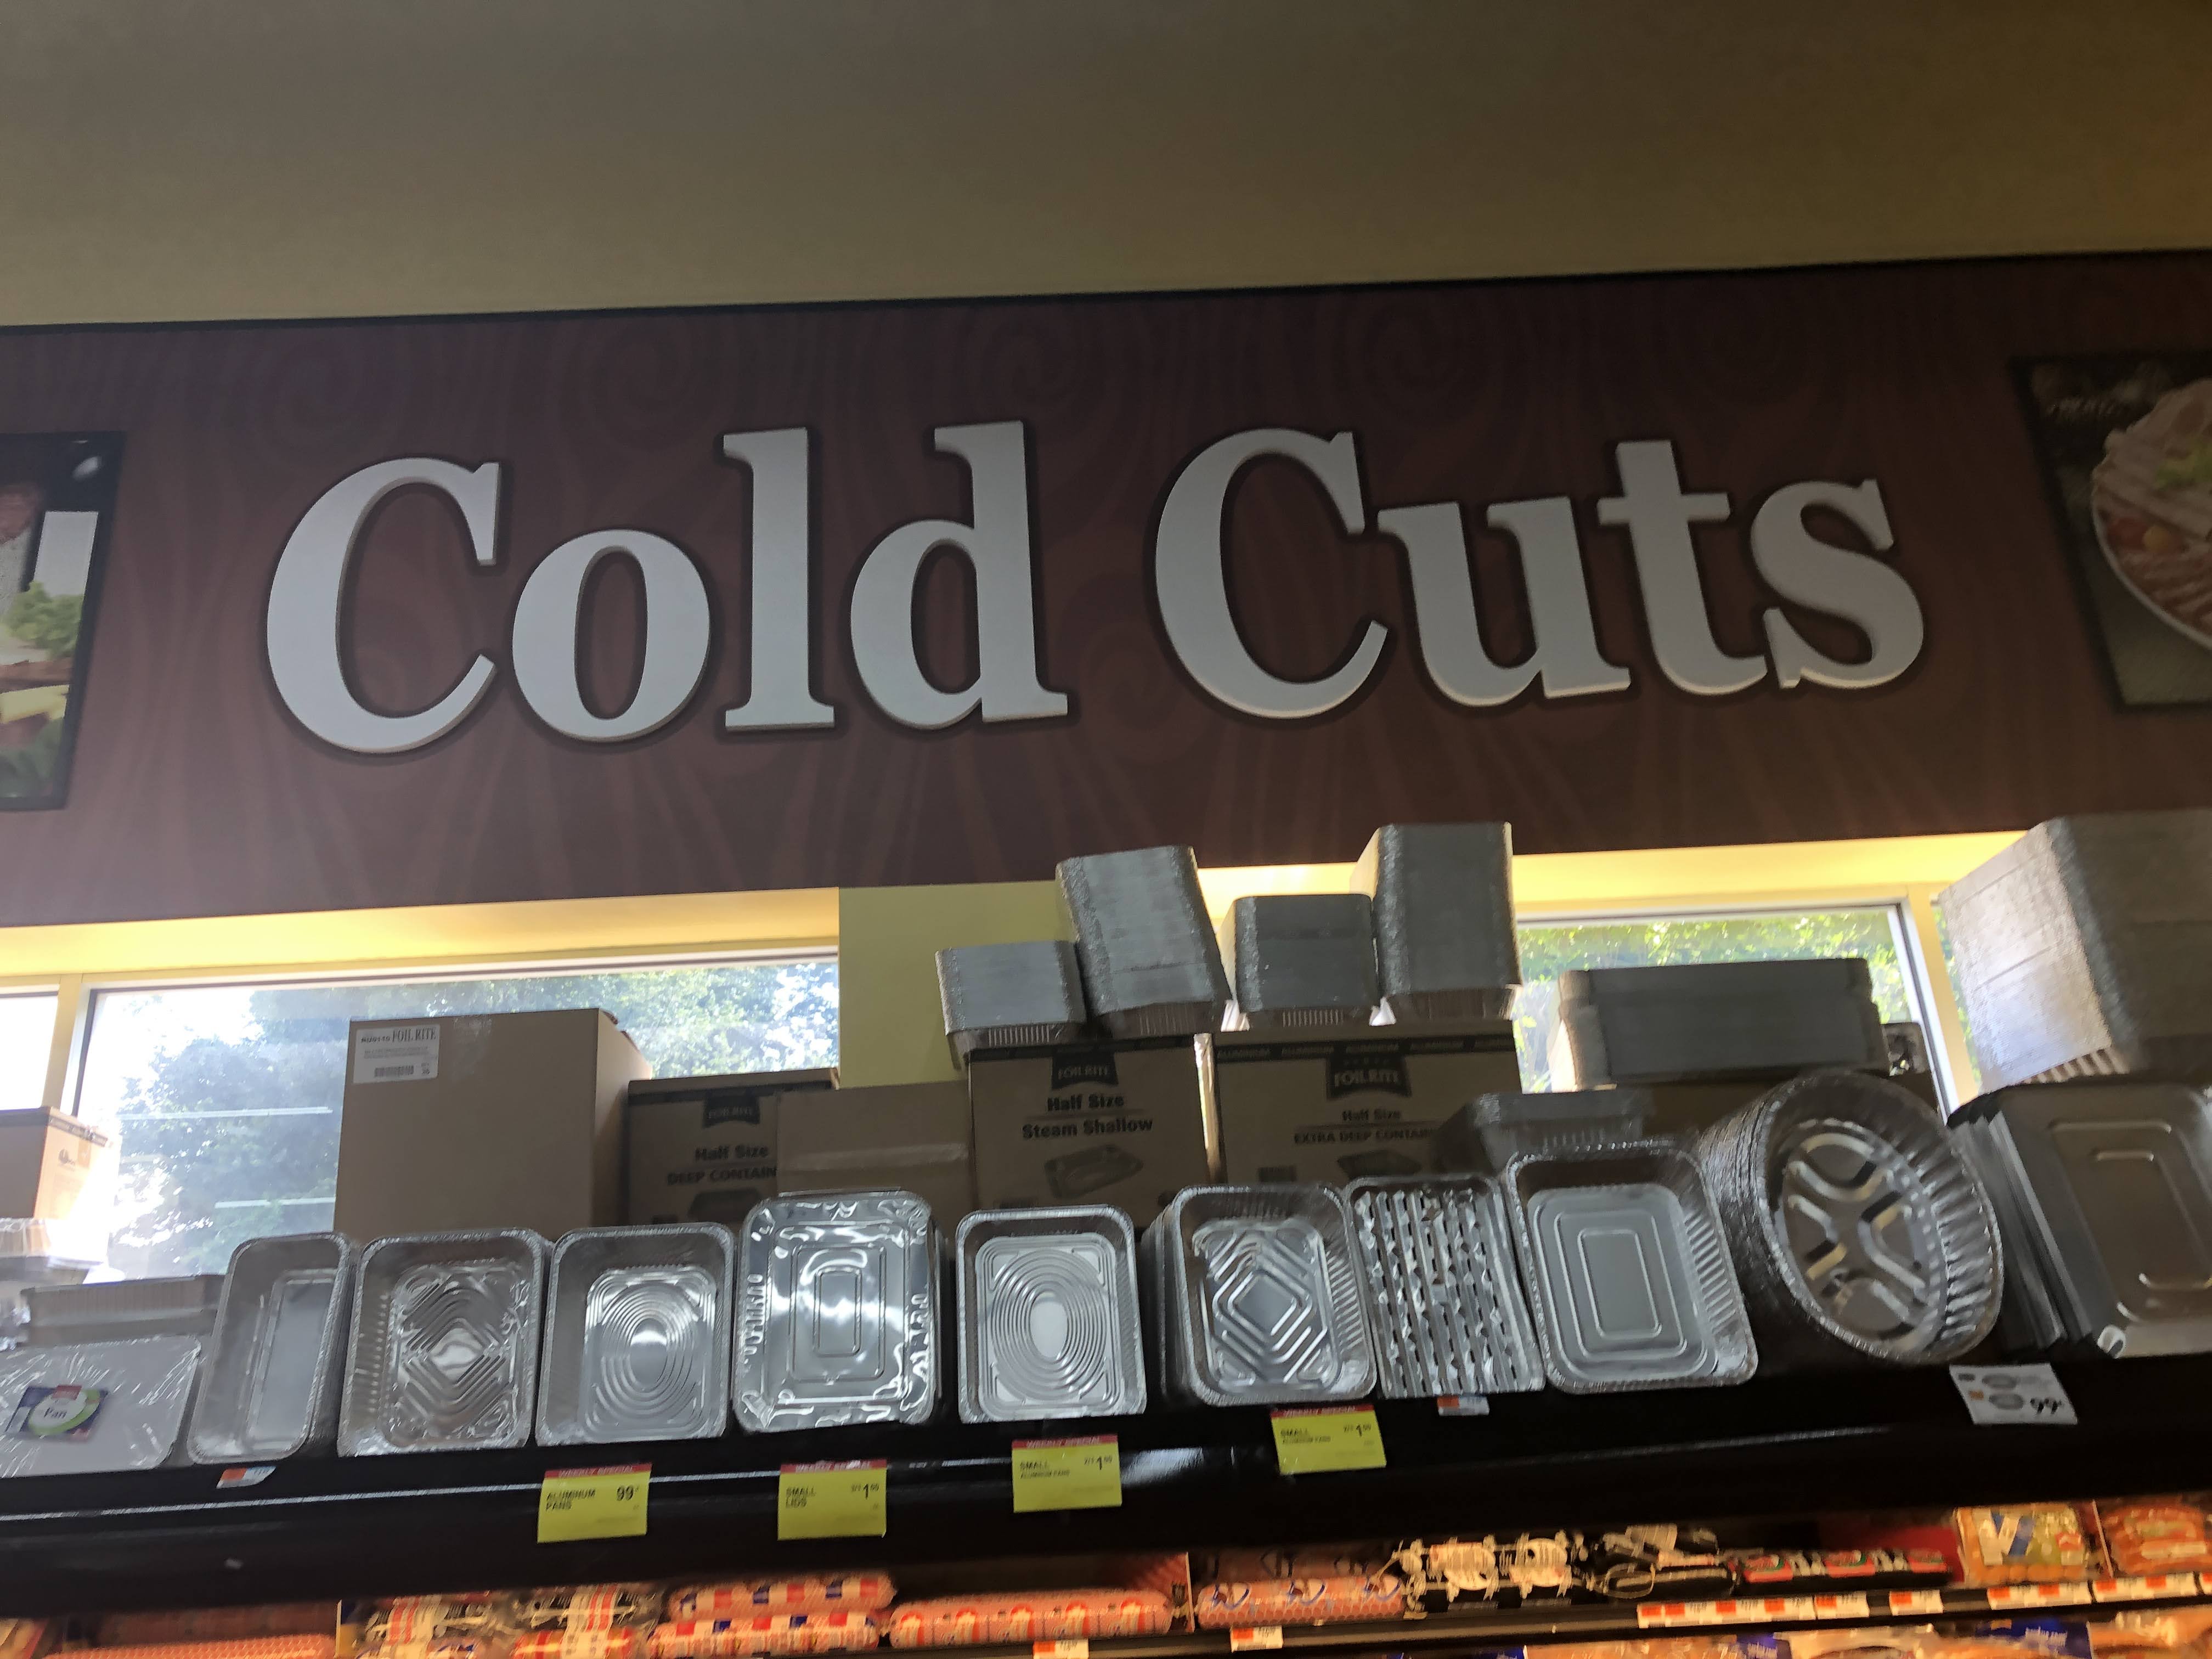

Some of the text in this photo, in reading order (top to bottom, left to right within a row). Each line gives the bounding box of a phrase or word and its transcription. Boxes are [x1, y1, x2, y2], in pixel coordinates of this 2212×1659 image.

[267, 420, 1925, 754] Cold Cuts
[392, 1027, 436, 1042] FOIL RITE
[1047, 1093, 1125, 1111] Half Size
[1341, 1108, 1401, 1122] Half Size
[1022, 1117, 1153, 1139] Steam Shallow
[1294, 1132, 1336, 1144] EXTRA
[694, 1144, 769, 1160] Half Size
[667, 1171, 705, 1185] DEEP
[43, 1407, 67, 1419] Pan
[546, 1488, 596, 1501] ALUMINUM
